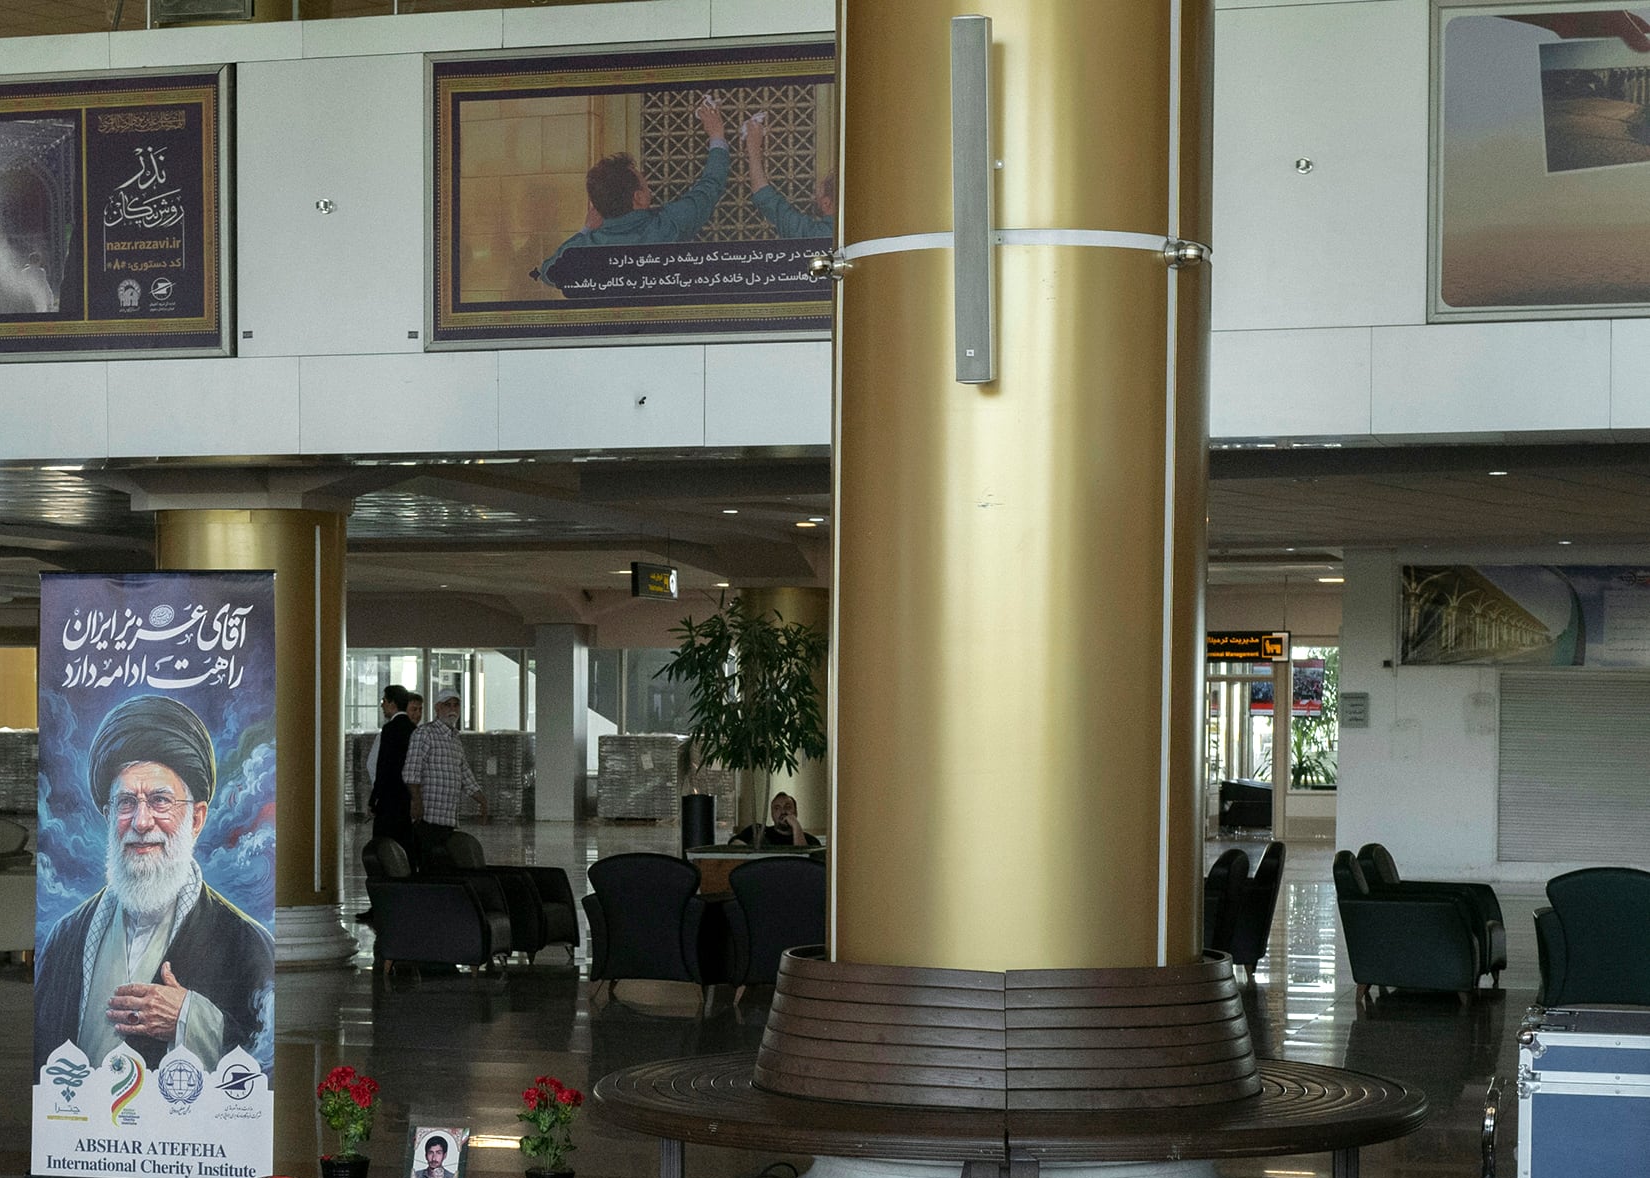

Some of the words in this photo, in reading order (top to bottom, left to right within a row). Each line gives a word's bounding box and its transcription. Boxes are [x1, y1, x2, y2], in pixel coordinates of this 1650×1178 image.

[106, 237, 182, 250] nazr.razavi.ir
[636, 253, 661, 267] عشق
[663, 255, 676, 266] در
[677, 252, 704, 265] ریشه
[705, 250, 719, 262] که
[765, 250, 787, 263] حرم
[788, 250, 801, 261] در
[598, 275, 625, 291] کلامی
[625, 277, 638, 290] به
[639, 275, 657, 289] نیاز
[723, 273, 743, 286] خانه
[745, 272, 761, 286] دل
[763, 275, 776, 287] در
[61, 607, 118, 651] ایران
[196, 602, 255, 651] آقای
[61, 654, 98, 689] دارد
[94, 654, 148, 689] ادامه
[74, 1137, 143, 1155] ABSHAR
[147, 1141, 227, 1159] ATEFEHA
[45, 1154, 137, 1173] International
[140, 1157, 194, 1178] Cherity
[197, 1160, 257, 1178] Institute
